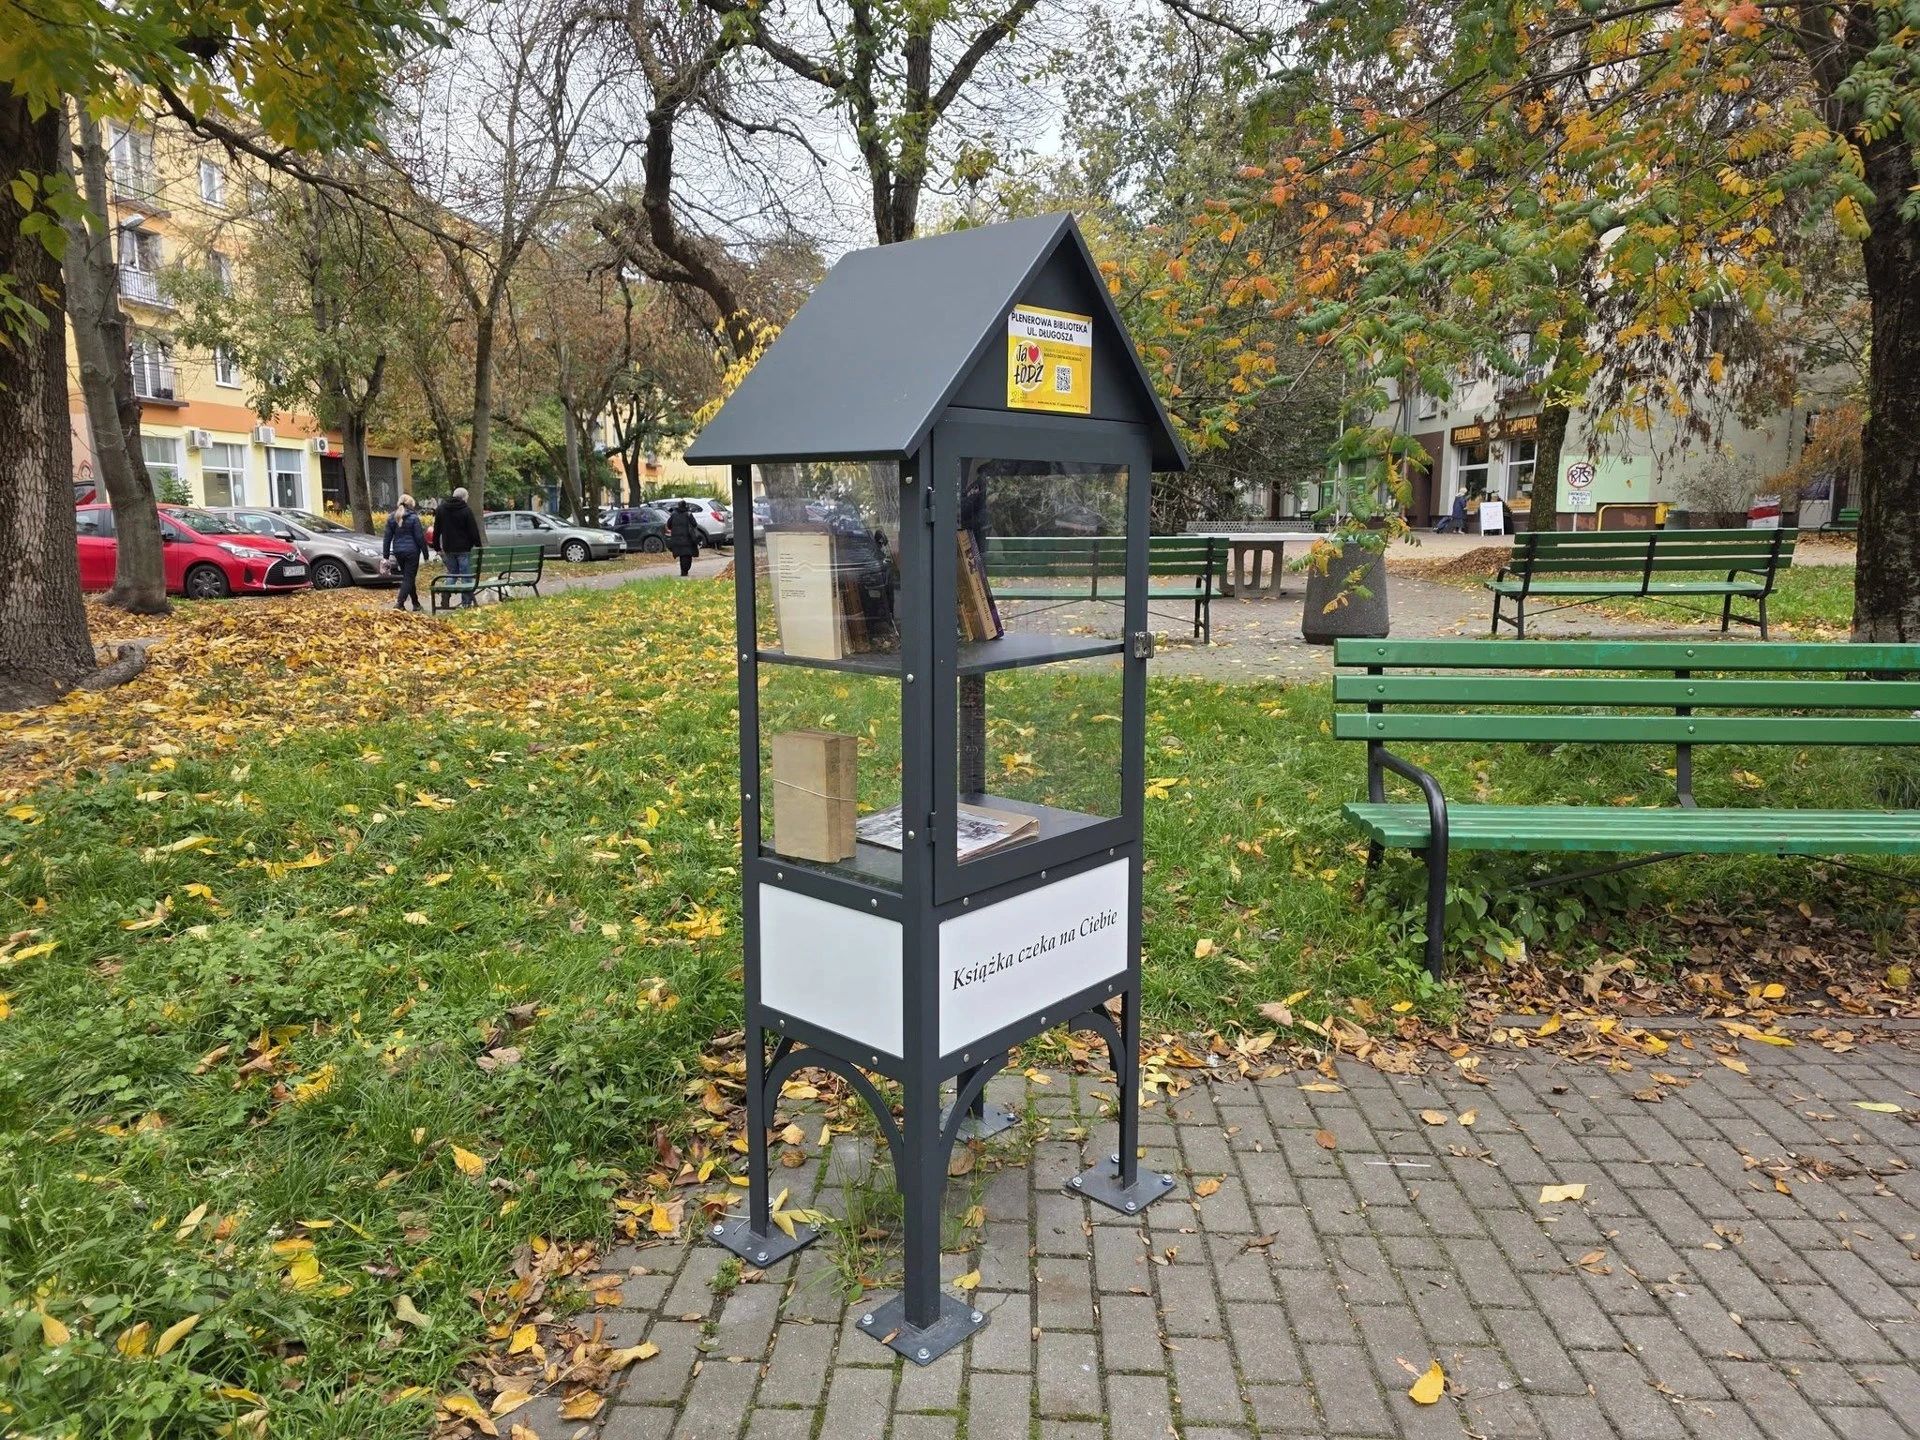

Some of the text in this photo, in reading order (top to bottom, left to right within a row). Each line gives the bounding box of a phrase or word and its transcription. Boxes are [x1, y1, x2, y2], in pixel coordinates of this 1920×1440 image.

[1011, 312, 1088, 333] PLENEROWA BIBLIOTEKA
[1027, 326, 1074, 342] UL. DŁUGOSZA
[952, 908, 1118, 990] Książka czeka na Ciebie
